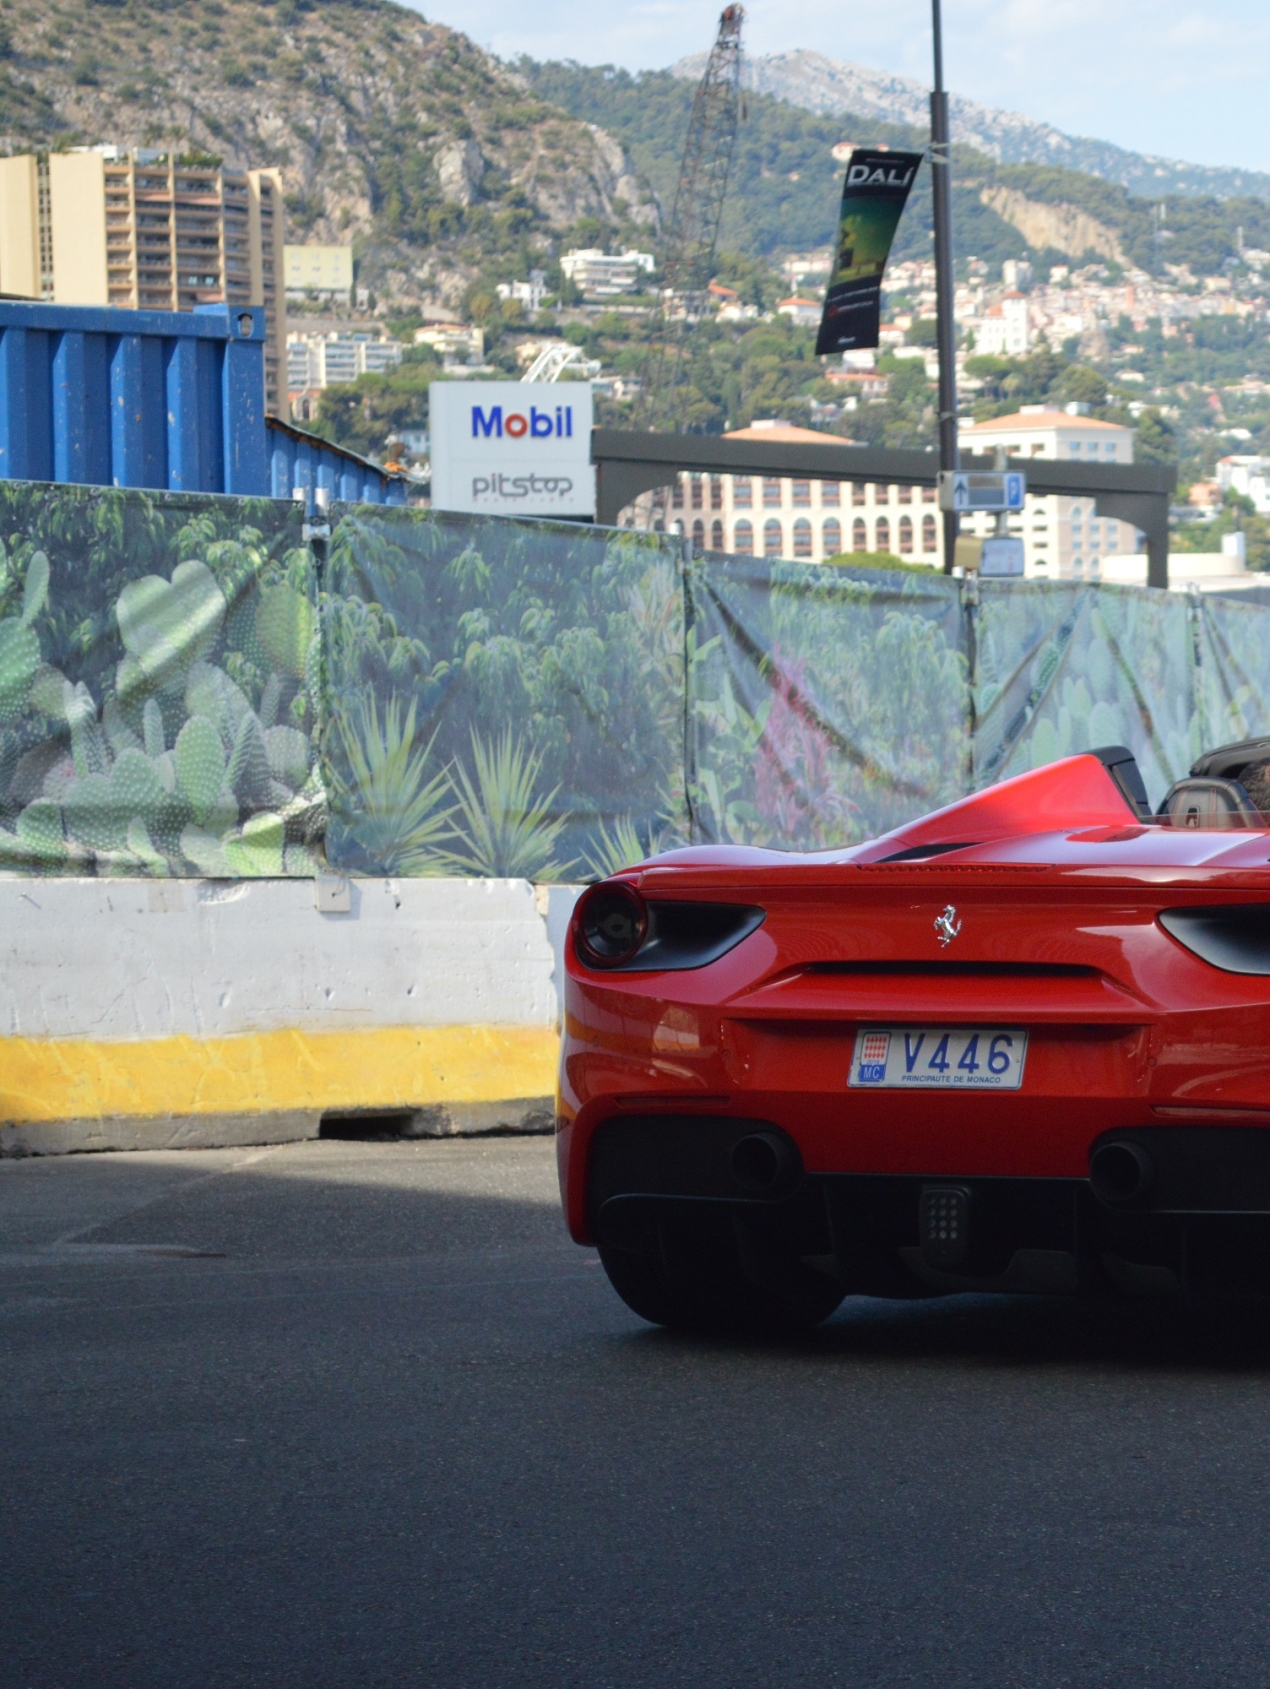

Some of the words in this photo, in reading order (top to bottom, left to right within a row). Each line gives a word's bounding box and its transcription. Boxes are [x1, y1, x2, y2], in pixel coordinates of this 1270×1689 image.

[472, 406, 573, 438] Mobil
[472, 473, 573, 497] pitstop
[904, 1033, 1014, 1074] V446
[863, 1066, 880, 1079] MC
[901, 1075, 950, 1083] PRINCIPAUTE
[967, 1076, 1001, 1084] MONACO
